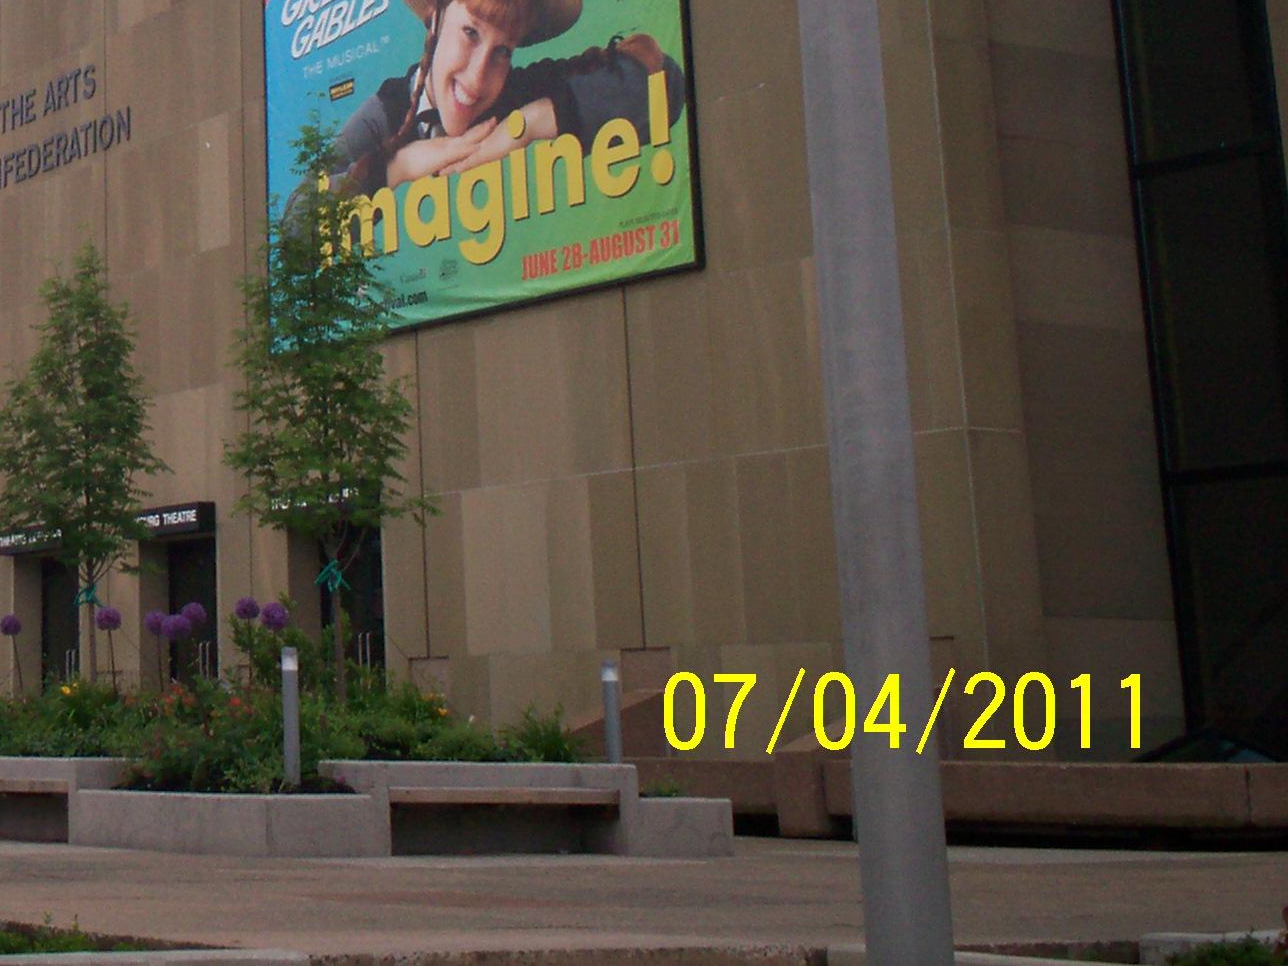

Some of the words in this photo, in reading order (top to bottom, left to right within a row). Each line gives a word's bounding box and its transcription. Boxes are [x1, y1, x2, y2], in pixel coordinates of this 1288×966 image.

[0, 89, 37, 135] THE
[43, 64, 97, 117] ARTS
[303, 61, 322, 79] THE
[318, 70, 676, 267] imagine!
[522, 249, 558, 281] JUNE
[659, 219, 680, 249] 31
[162, 509, 198, 526] THEATRE
